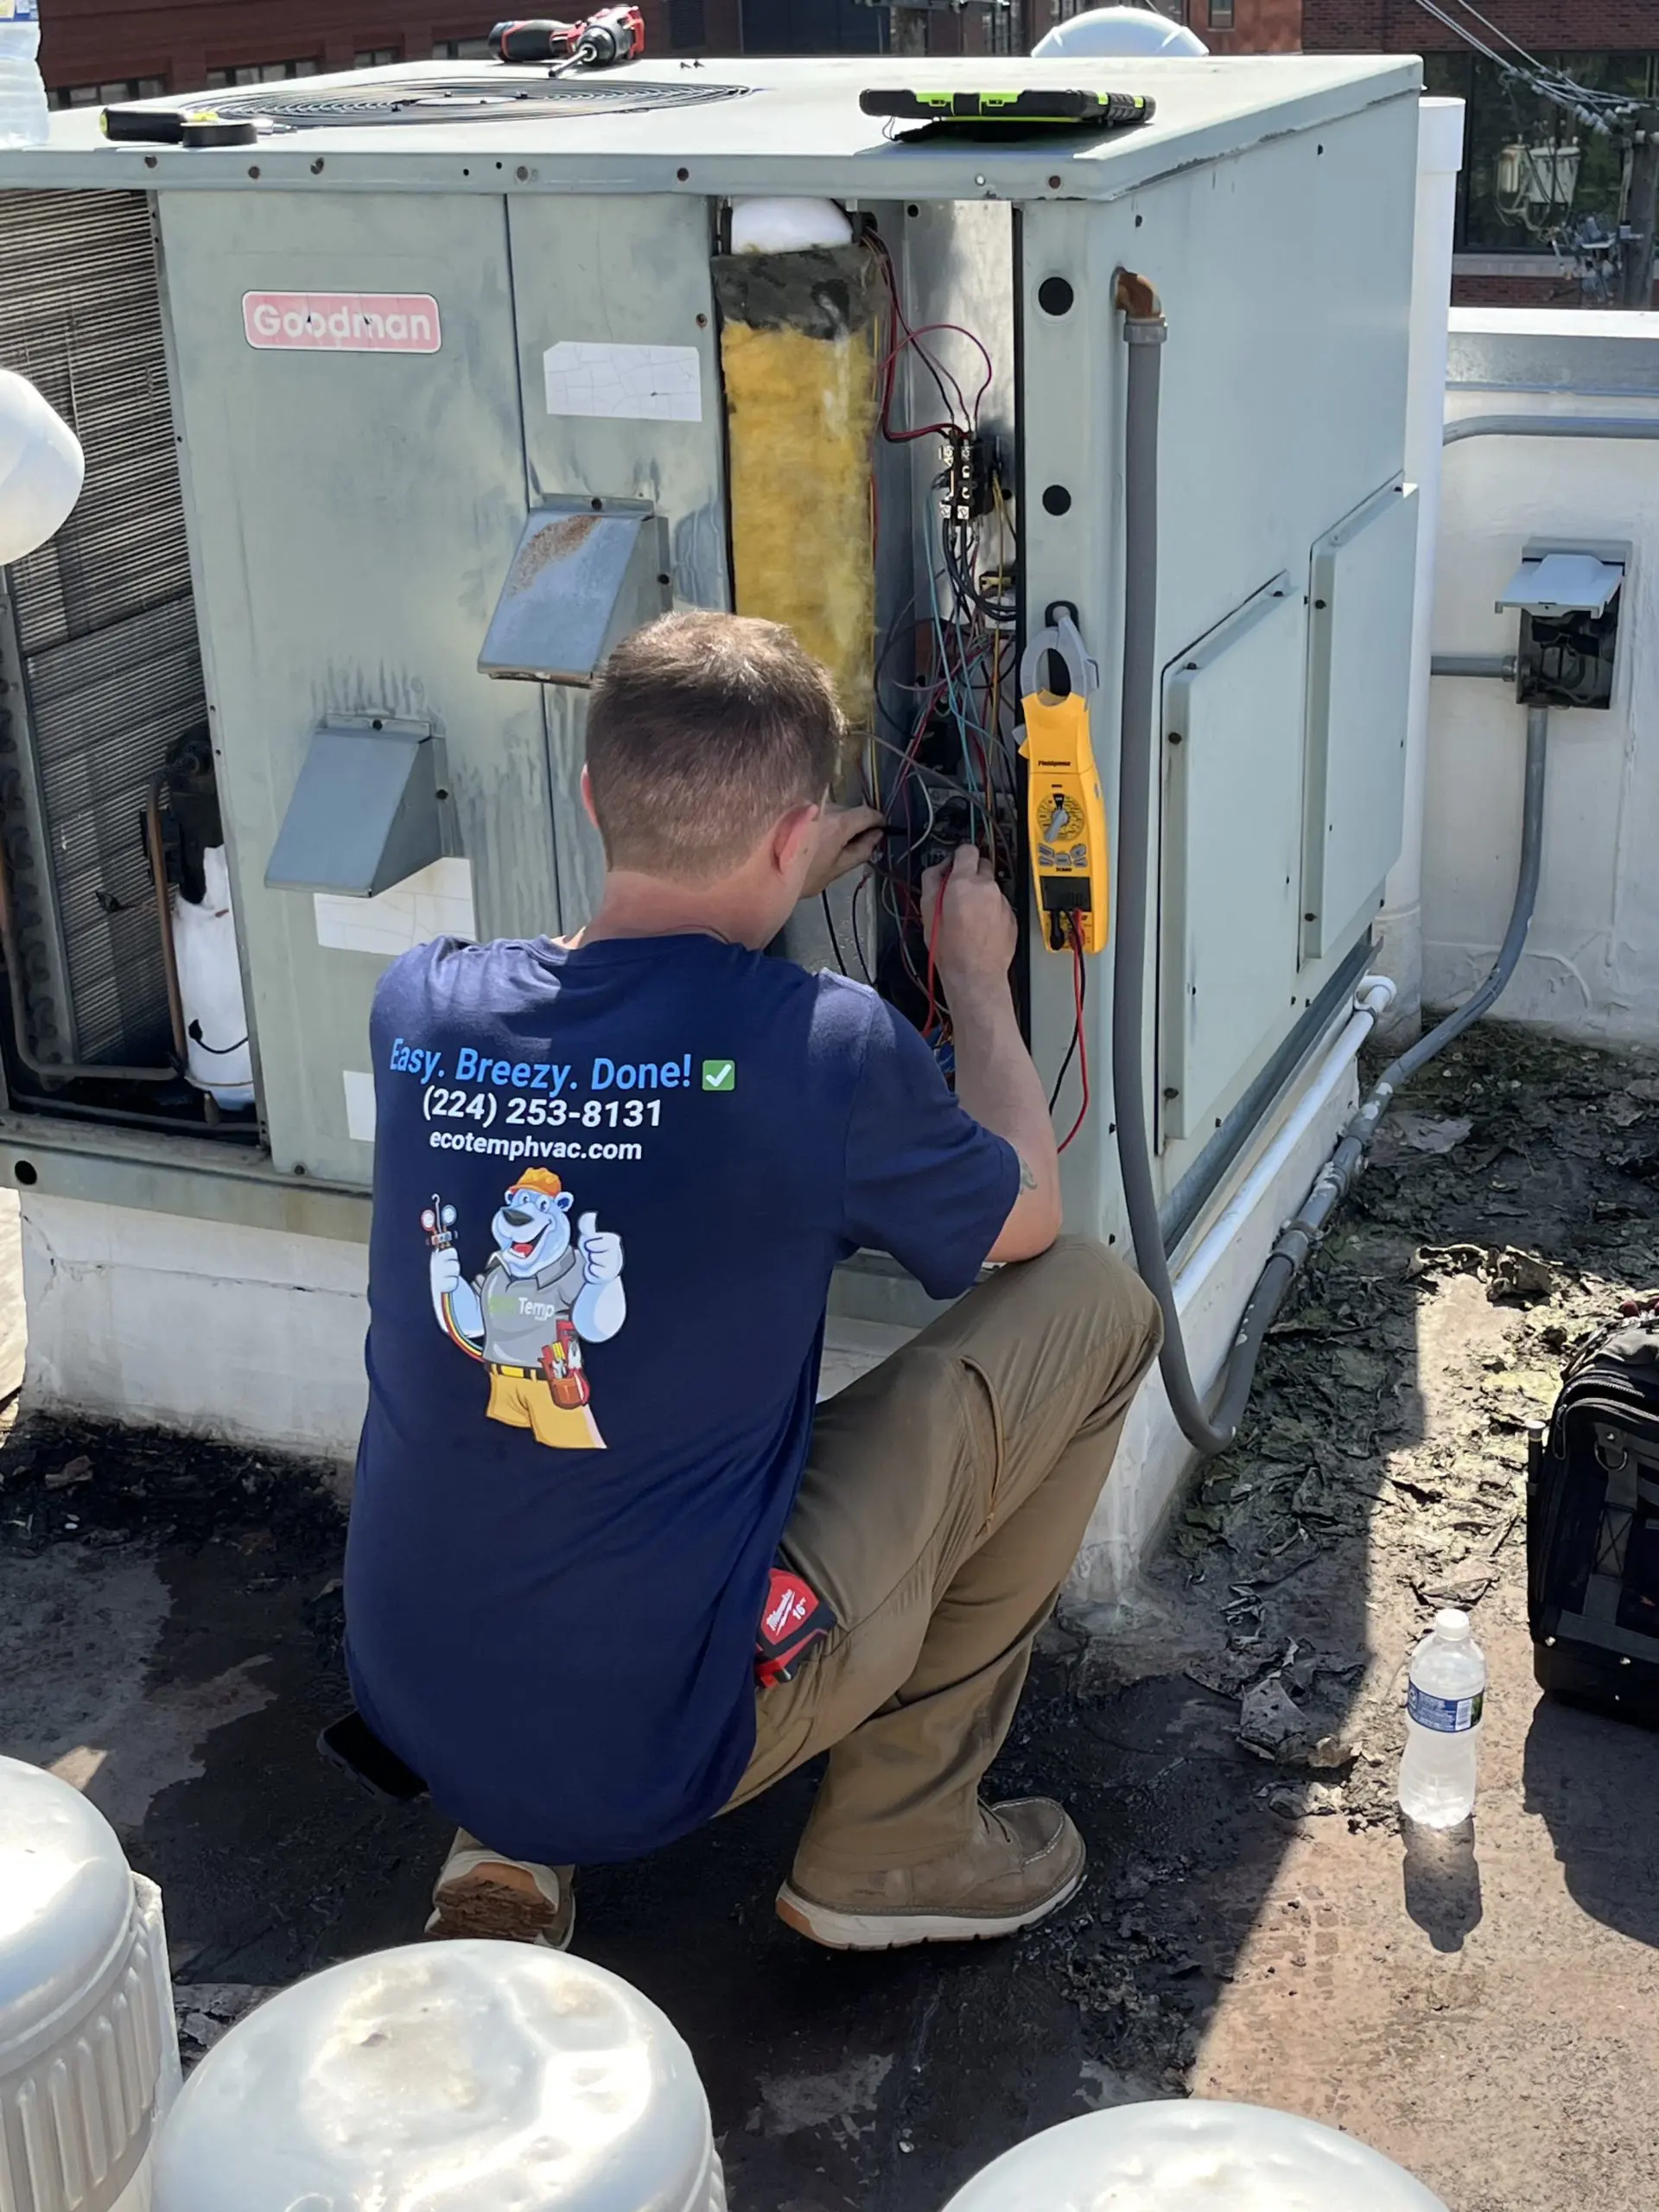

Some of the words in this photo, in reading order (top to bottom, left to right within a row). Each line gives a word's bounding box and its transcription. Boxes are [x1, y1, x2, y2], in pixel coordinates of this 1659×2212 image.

[253, 303, 431, 340] Goodman
[390, 1037, 445, 1085] Easy.
[455, 1046, 578, 1098] Breezy.
[591, 1053, 692, 1090] Done!
[423, 1084, 498, 1128] (224)
[505, 1097, 662, 1128] 253-8131
[429, 1130, 643, 1162] ecotemphvac.com
